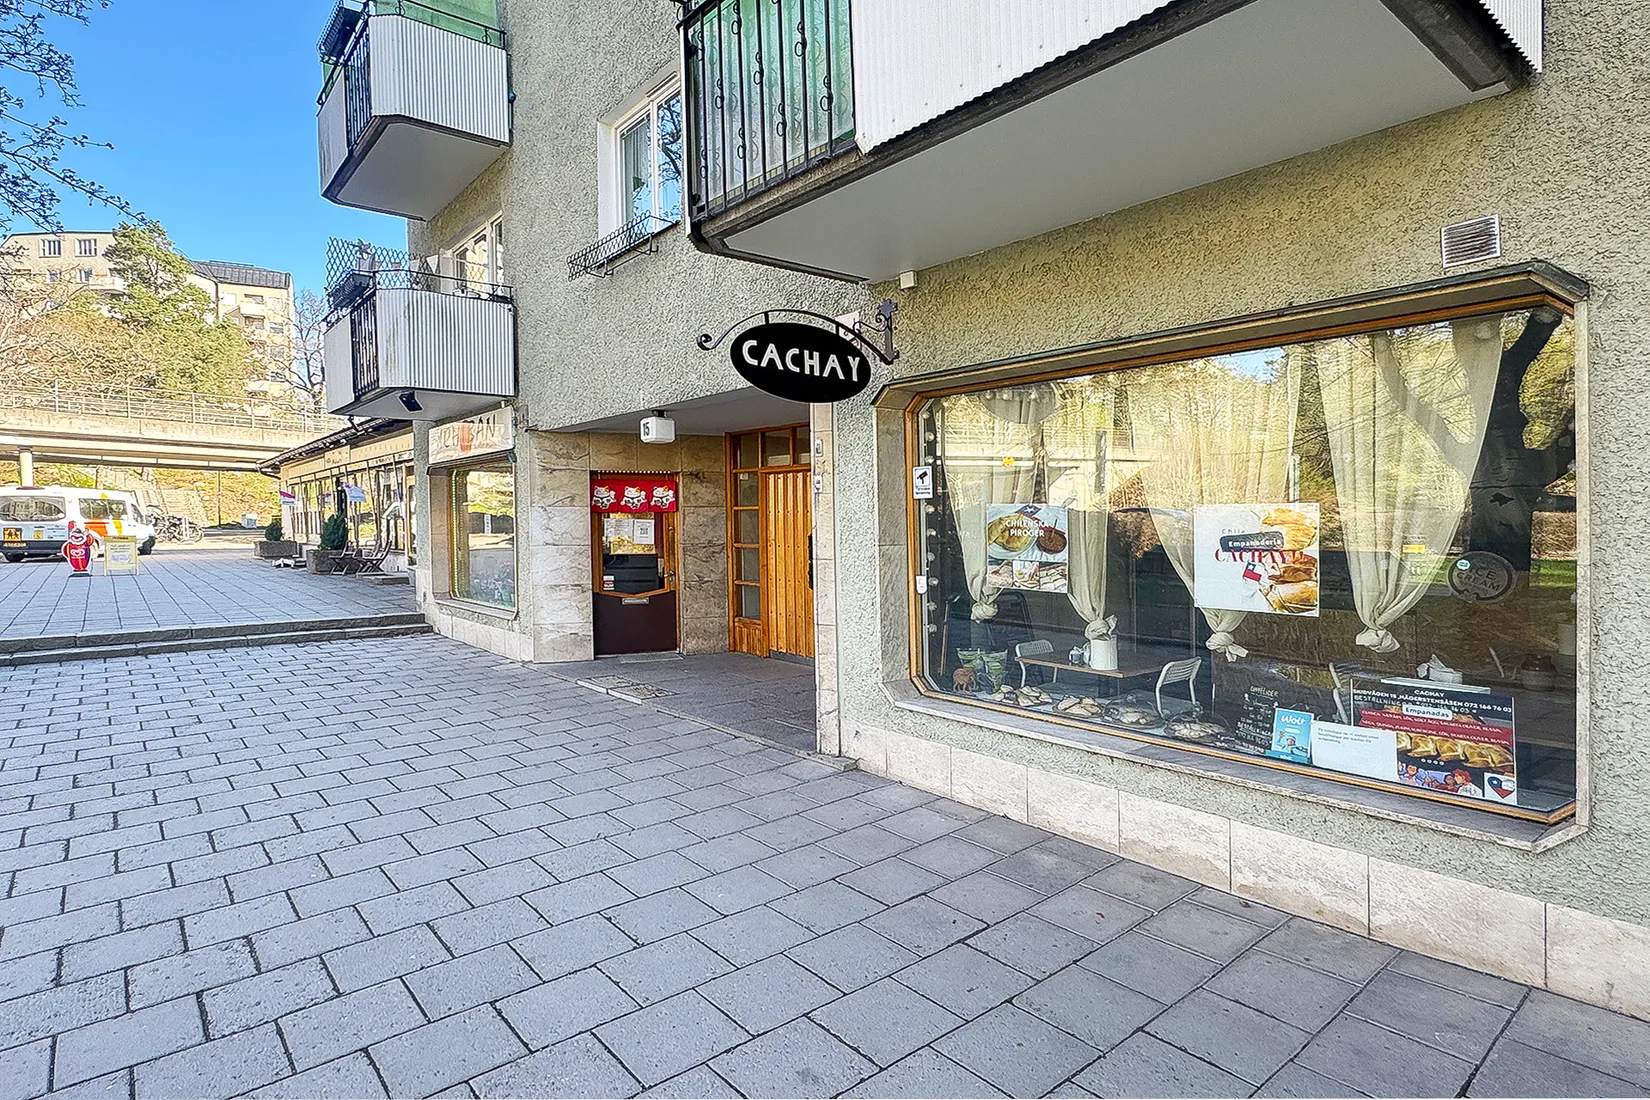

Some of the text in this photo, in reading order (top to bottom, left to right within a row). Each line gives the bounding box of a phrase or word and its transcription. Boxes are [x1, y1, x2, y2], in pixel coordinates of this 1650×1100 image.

[742, 340, 860, 382] CACHAY
[642, 421, 650, 437] 15
[1005, 519, 1049, 528] CHILENSKA
[1010, 529, 1045, 537] PIROGER
[1456, 571, 1500, 591] CREAM
[1414, 689, 1445, 698] CACHAY
[1464, 701, 1478, 709] 072
[1405, 707, 1449, 718] Empanadas
